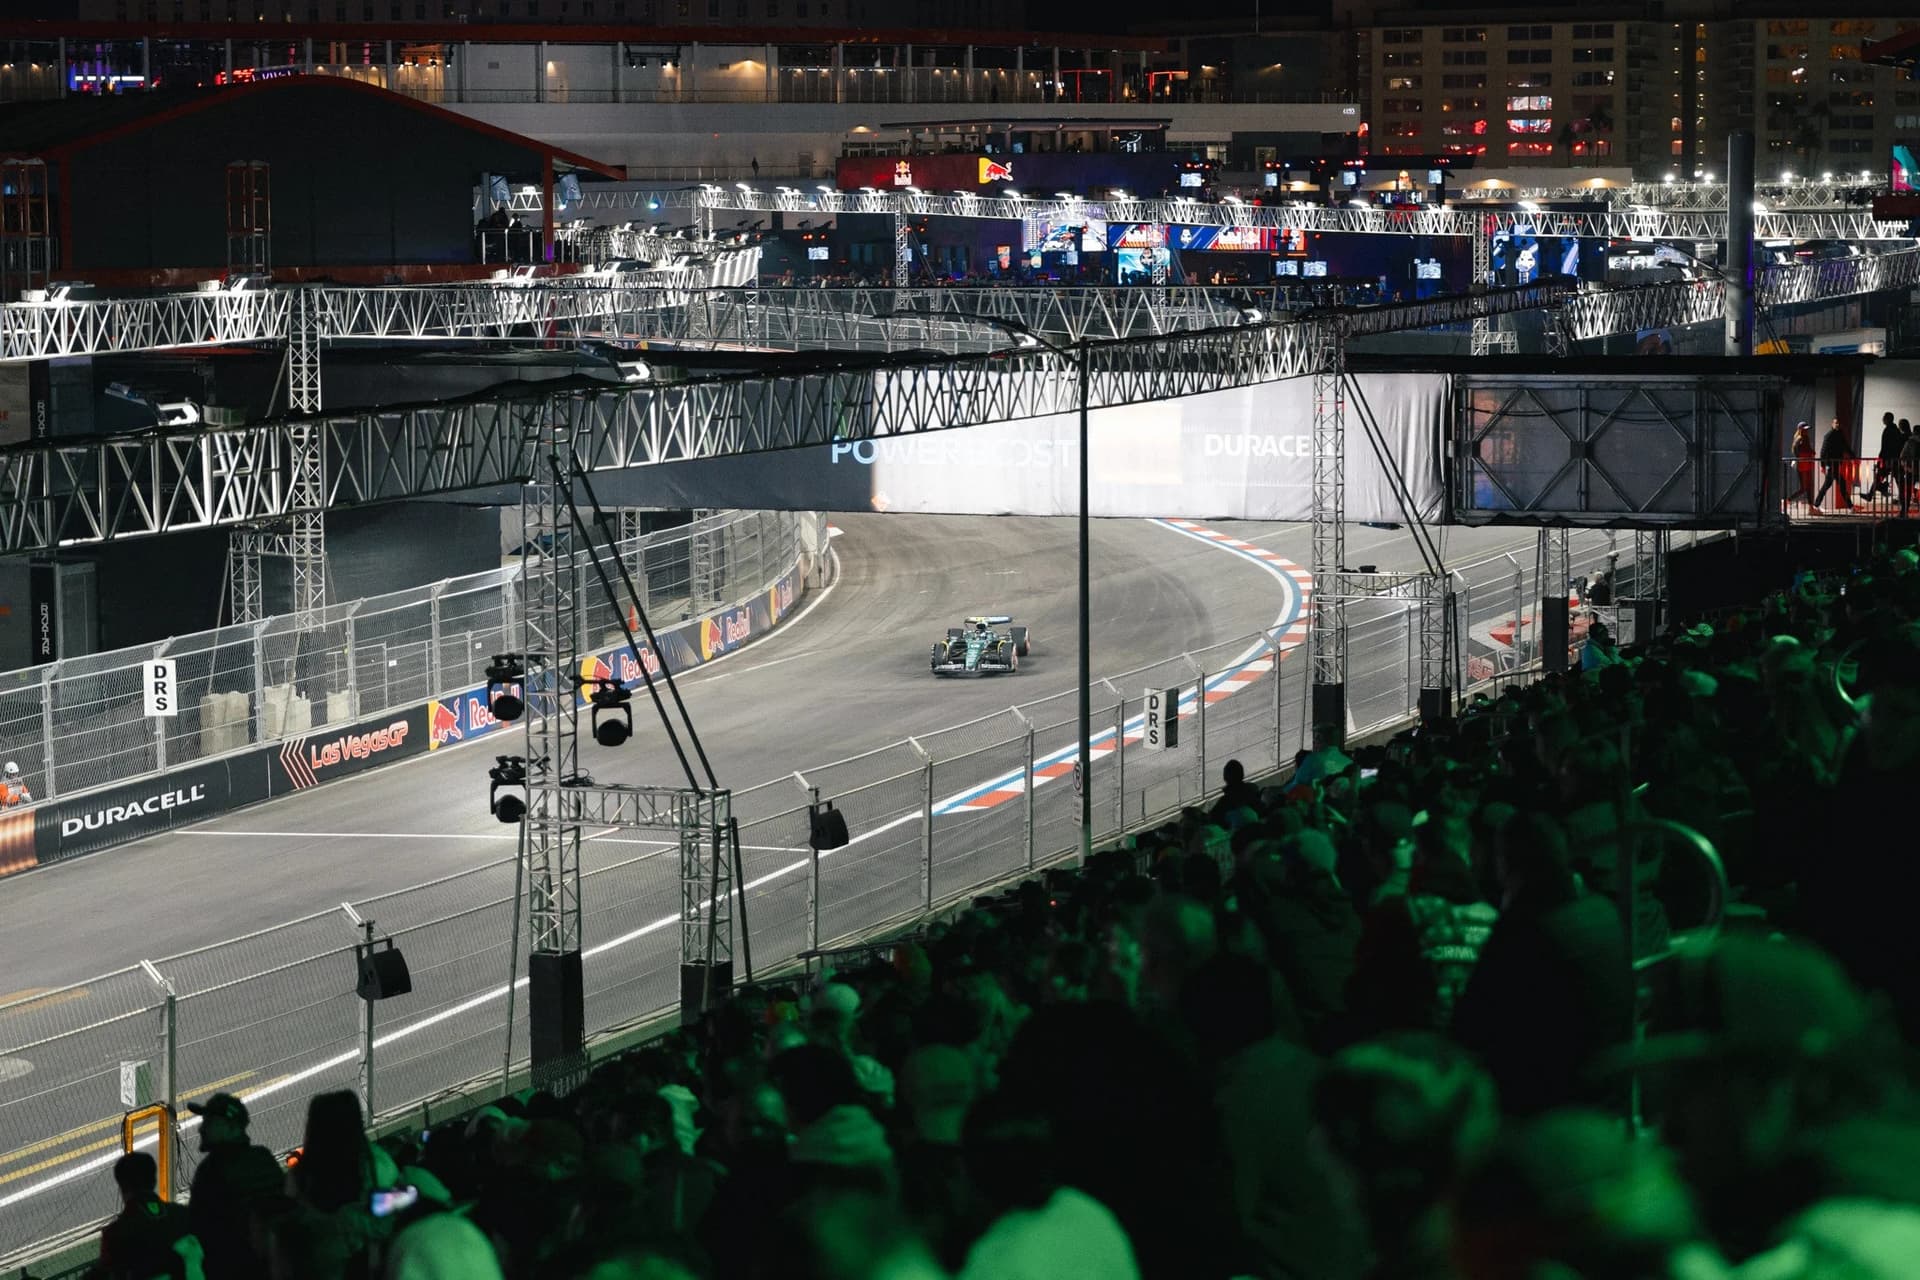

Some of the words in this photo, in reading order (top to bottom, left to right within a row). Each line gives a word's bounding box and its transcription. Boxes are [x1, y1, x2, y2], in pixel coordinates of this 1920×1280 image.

[153, 665, 168, 711] DRS
[1149, 695, 1159, 745] DRS
[62, 783, 205, 837] DURACELL
